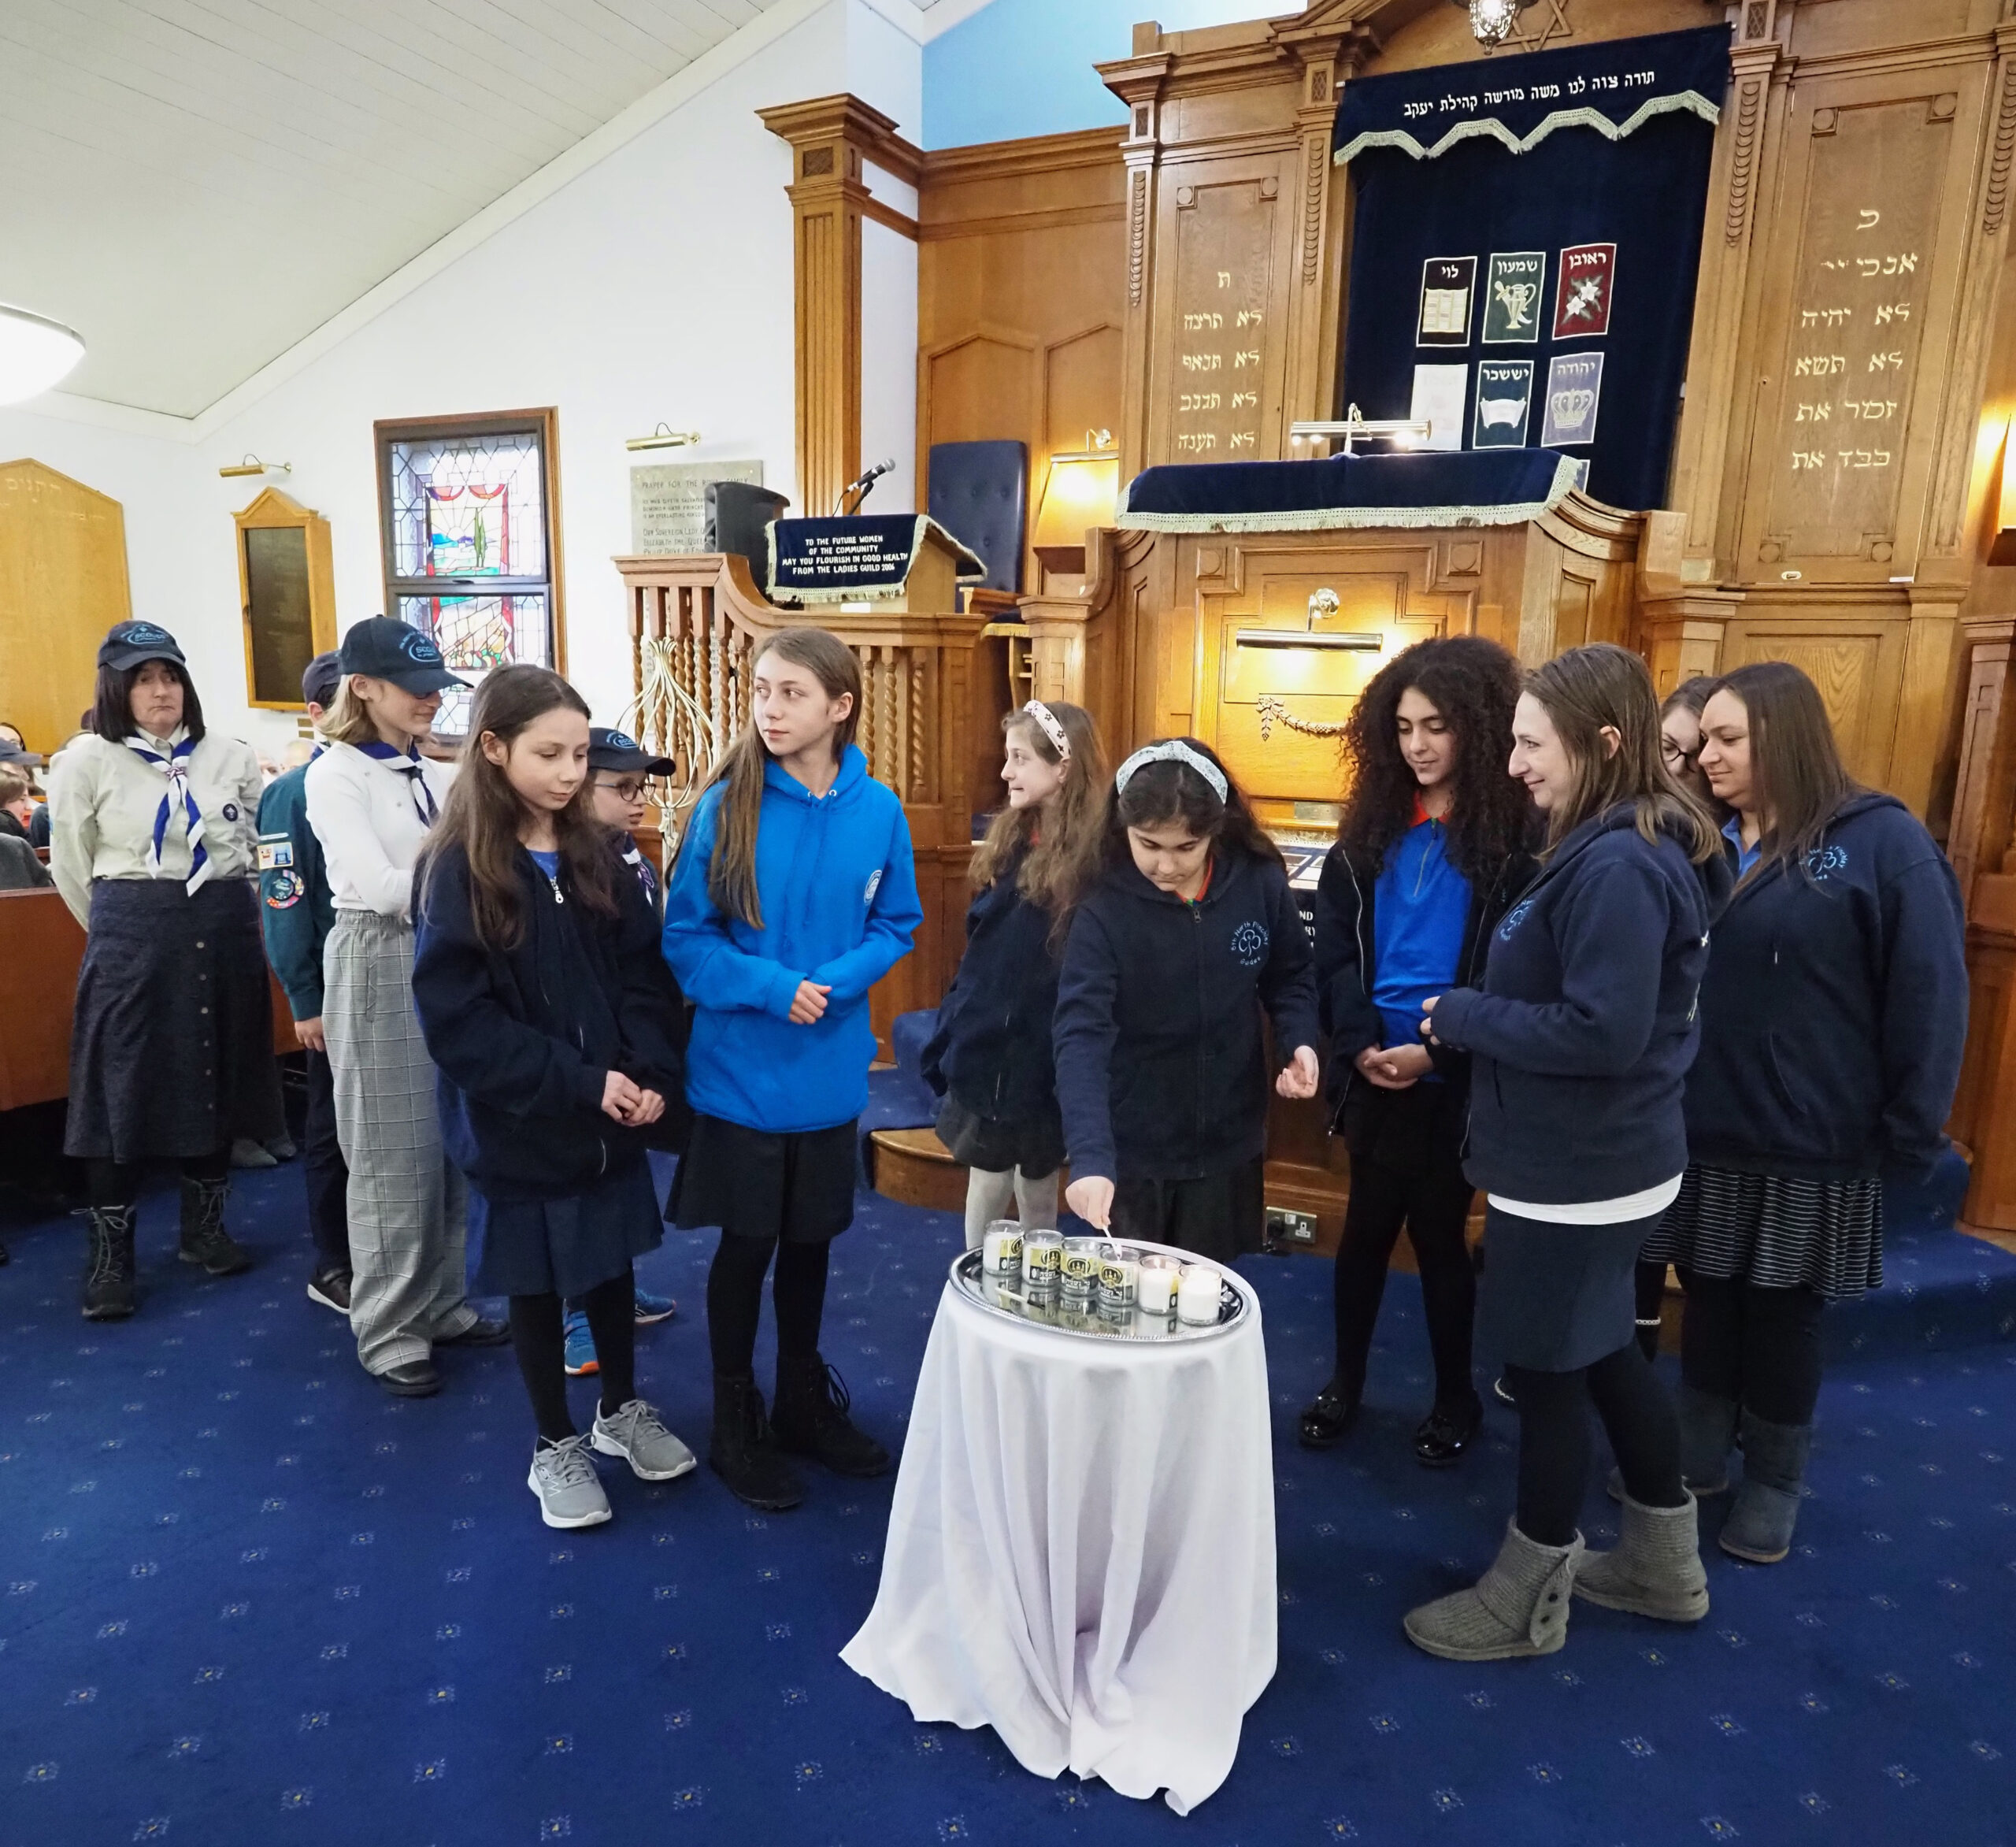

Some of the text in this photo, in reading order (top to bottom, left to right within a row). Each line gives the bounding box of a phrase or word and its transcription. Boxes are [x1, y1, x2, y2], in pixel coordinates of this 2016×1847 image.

[1403, 71, 1655, 119] תורה צוה לנו משה מורשה קהילת יעקב
[1497, 260, 1538, 276] שמעון
[1569, 252, 1606, 270] ראובן
[1856, 252, 1918, 276] אנכי
[1441, 264, 1459, 278] לוי
[1184, 310, 1262, 330] לא תרצח
[1802, 302, 1910, 328] לא יהיה
[1182, 350, 1260, 372] לא תנאף
[1557, 362, 1595, 375] יהודה
[1795, 350, 1903, 376] לא תשא
[1483, 368, 1529, 381] יששכר
[1232, 391, 1257, 409] לא
[1795, 402, 1832, 421] את
[1178, 431, 1254, 454] לא תענה
[1792, 448, 1891, 469] כבד את
[836, 545, 878, 554] COMMUNITY
[834, 565, 858, 573] LADIES
